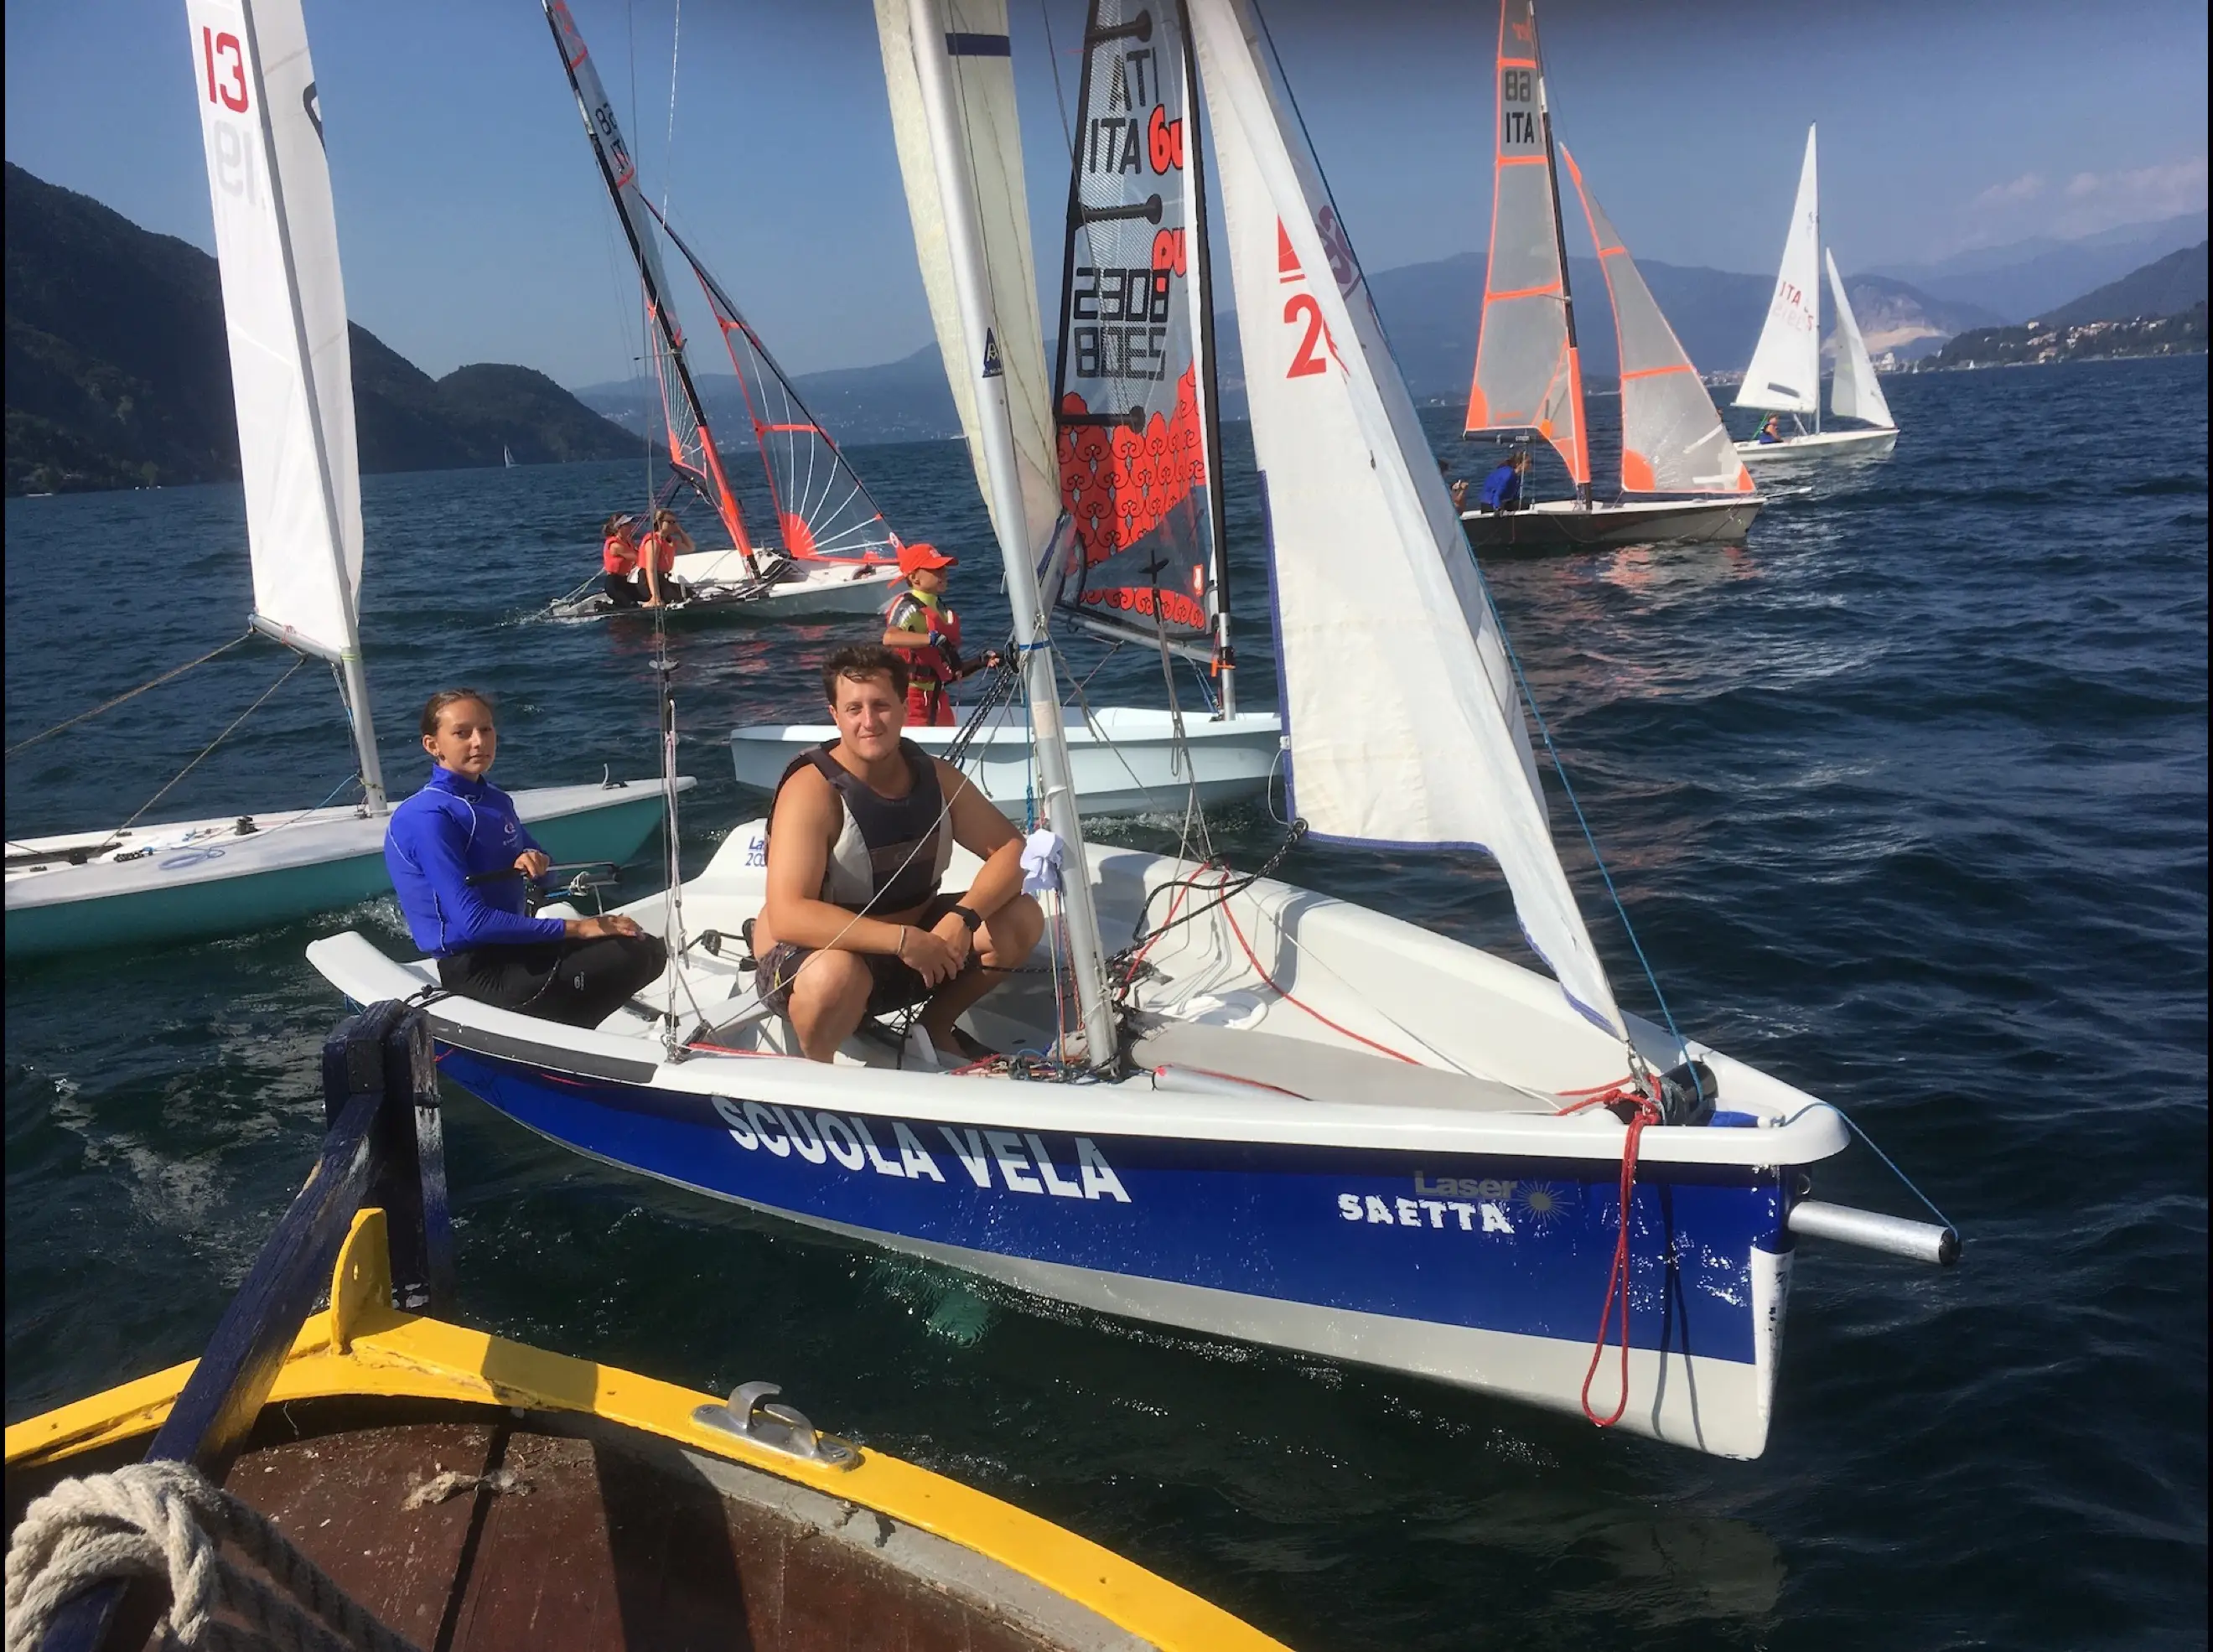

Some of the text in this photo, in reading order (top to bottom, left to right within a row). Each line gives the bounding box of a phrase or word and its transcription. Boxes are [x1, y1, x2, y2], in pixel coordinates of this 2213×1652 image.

[203, 26, 249, 113] 13
[1090, 117, 1142, 174] ITA
[1506, 111, 1535, 143] ITA
[1074, 267, 1171, 323] 2308
[711, 1095, 1132, 1203] SCUOLA VELA
[1414, 1171, 1518, 1199] Laser
[1337, 1193, 1516, 1234] SAETTA
